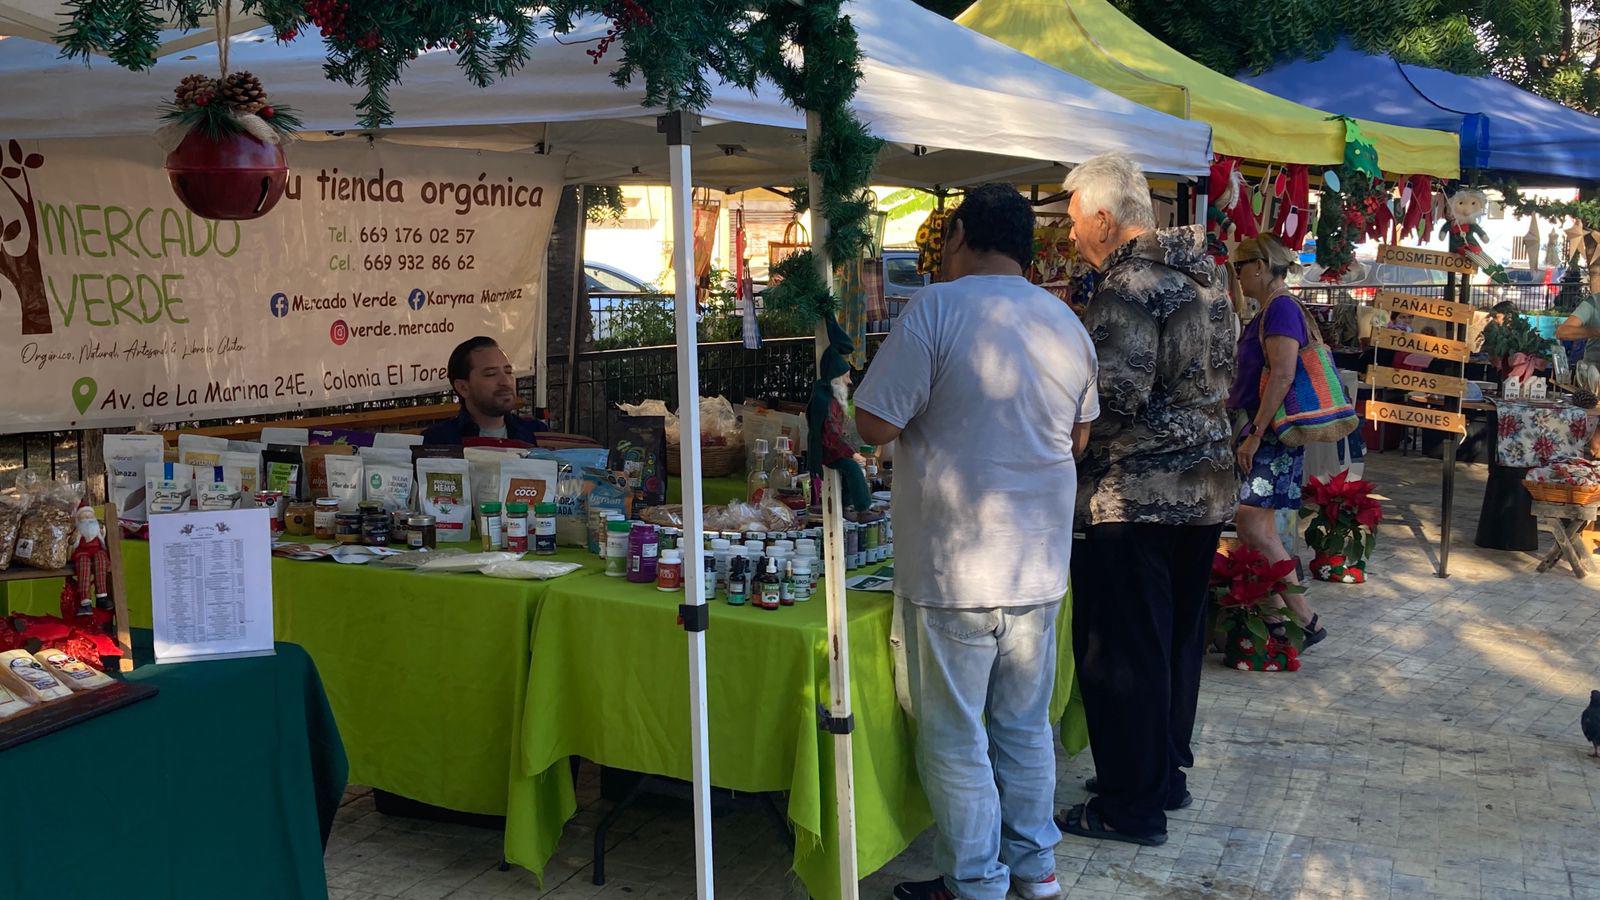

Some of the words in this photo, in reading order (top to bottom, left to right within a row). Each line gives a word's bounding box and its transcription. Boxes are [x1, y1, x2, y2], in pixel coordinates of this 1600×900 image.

[284, 174, 301, 201] u
[317, 168, 404, 202] tienda
[420, 172, 544, 215] orgánica
[38, 200, 241, 258] MERCADO
[328, 226, 352, 243] Tel.
[359, 227, 388, 243] 669
[395, 227, 423, 243] 176
[429, 228, 449, 243] 02
[455, 229, 476, 244] 57
[329, 254, 355, 271] Cel.
[363, 255, 392, 271] 669
[398, 255, 425, 271] 932
[431, 255, 451, 271] 86
[457, 255, 476, 271] 62
[1385, 249, 1473, 270] COSMETICOS
[47, 273, 190, 327] VERDE
[291, 293, 347, 312] Mercado
[352, 291, 397, 308] Verde
[426, 291, 475, 309] Karyna
[1391, 296, 1453, 318] PAÑALES
[350, 318, 455, 338] verde.mercado
[1389, 335, 1449, 355] TOALLAS
[100, 389, 136, 410] Av.
[143, 385, 169, 407] de
[175, 384, 198, 406] La
[204, 380, 269, 404] Marina
[275, 372, 314, 397] 24E,
[323, 368, 381, 391] Colonia
[387, 364, 403, 386] El
[410, 364, 449, 382] Tore
[1391, 374, 1437, 389] COPAS
[1379, 407, 1450, 427] CALZONES
[514, 488, 538, 497] COCO
